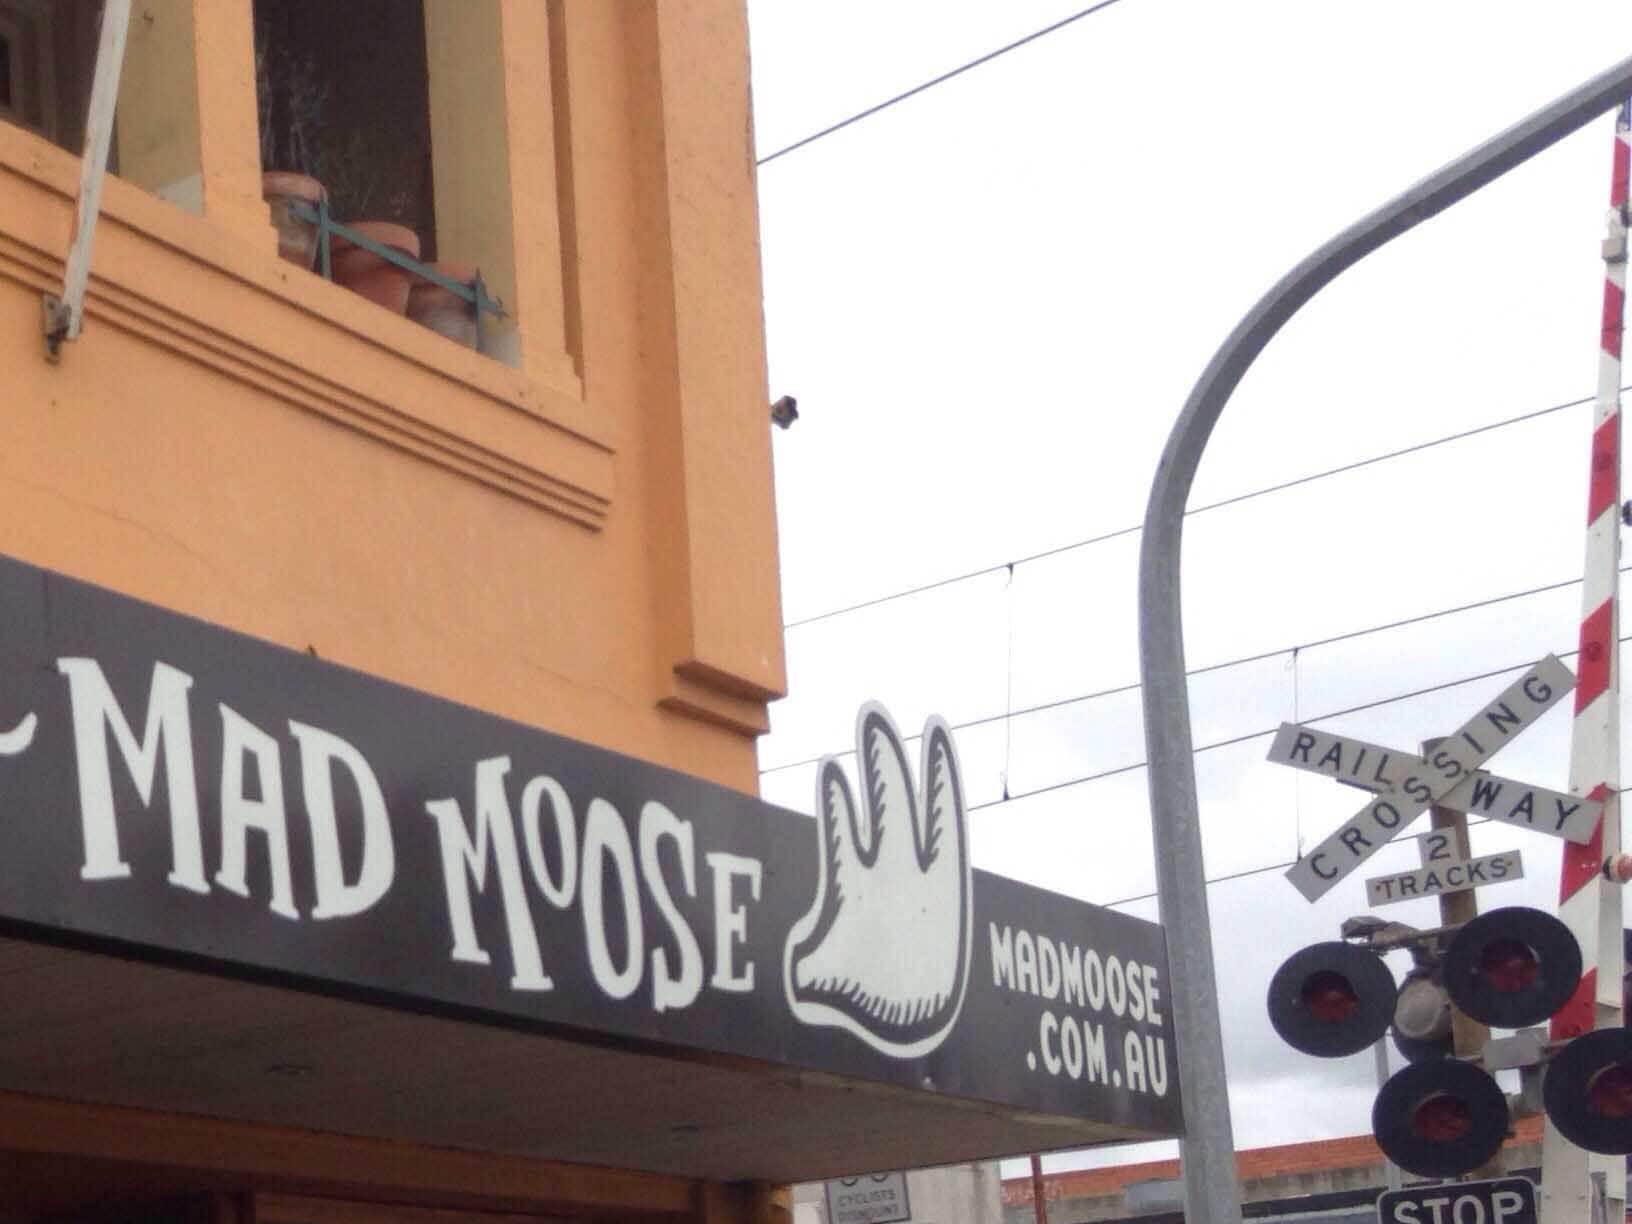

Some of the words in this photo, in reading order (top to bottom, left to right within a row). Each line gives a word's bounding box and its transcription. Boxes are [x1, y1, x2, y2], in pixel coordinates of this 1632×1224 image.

[57, 656, 395, 920] MAD
[425, 755, 763, 1013] MOOSE
[1426, 834, 1451, 862] 2
[1377, 855, 1510, 901] TRACKS
[988, 922, 1163, 1027] MADMOOSE
[1025, 1013, 1169, 1098] .COM.AU
